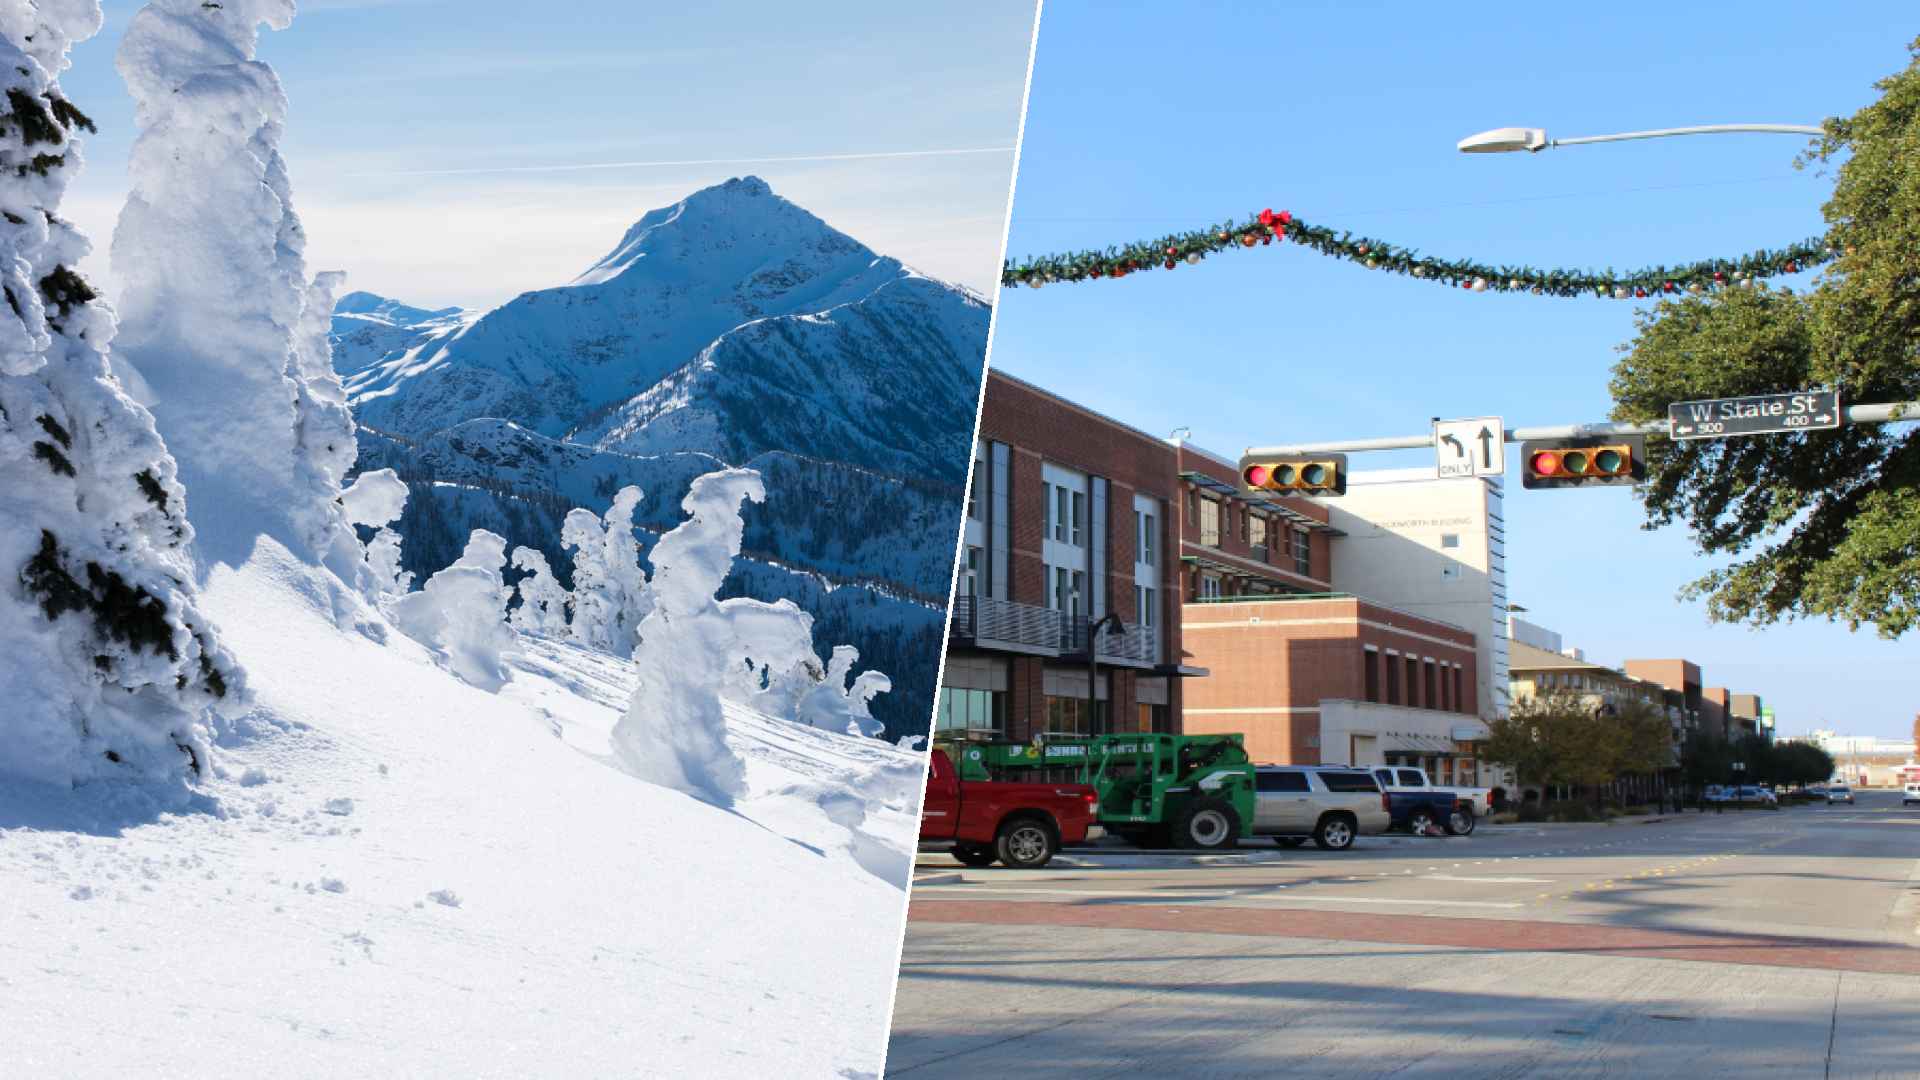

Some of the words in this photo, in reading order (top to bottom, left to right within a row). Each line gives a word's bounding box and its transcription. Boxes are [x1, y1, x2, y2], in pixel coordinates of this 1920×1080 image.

[1690, 404, 1712, 422] W
[1720, 400, 1784, 420] State
[1791, 396, 1817, 414] St
[1783, 415, 1809, 426] 400
[1697, 422, 1724, 434] 500
[1440, 463, 1472, 474] ONLY
